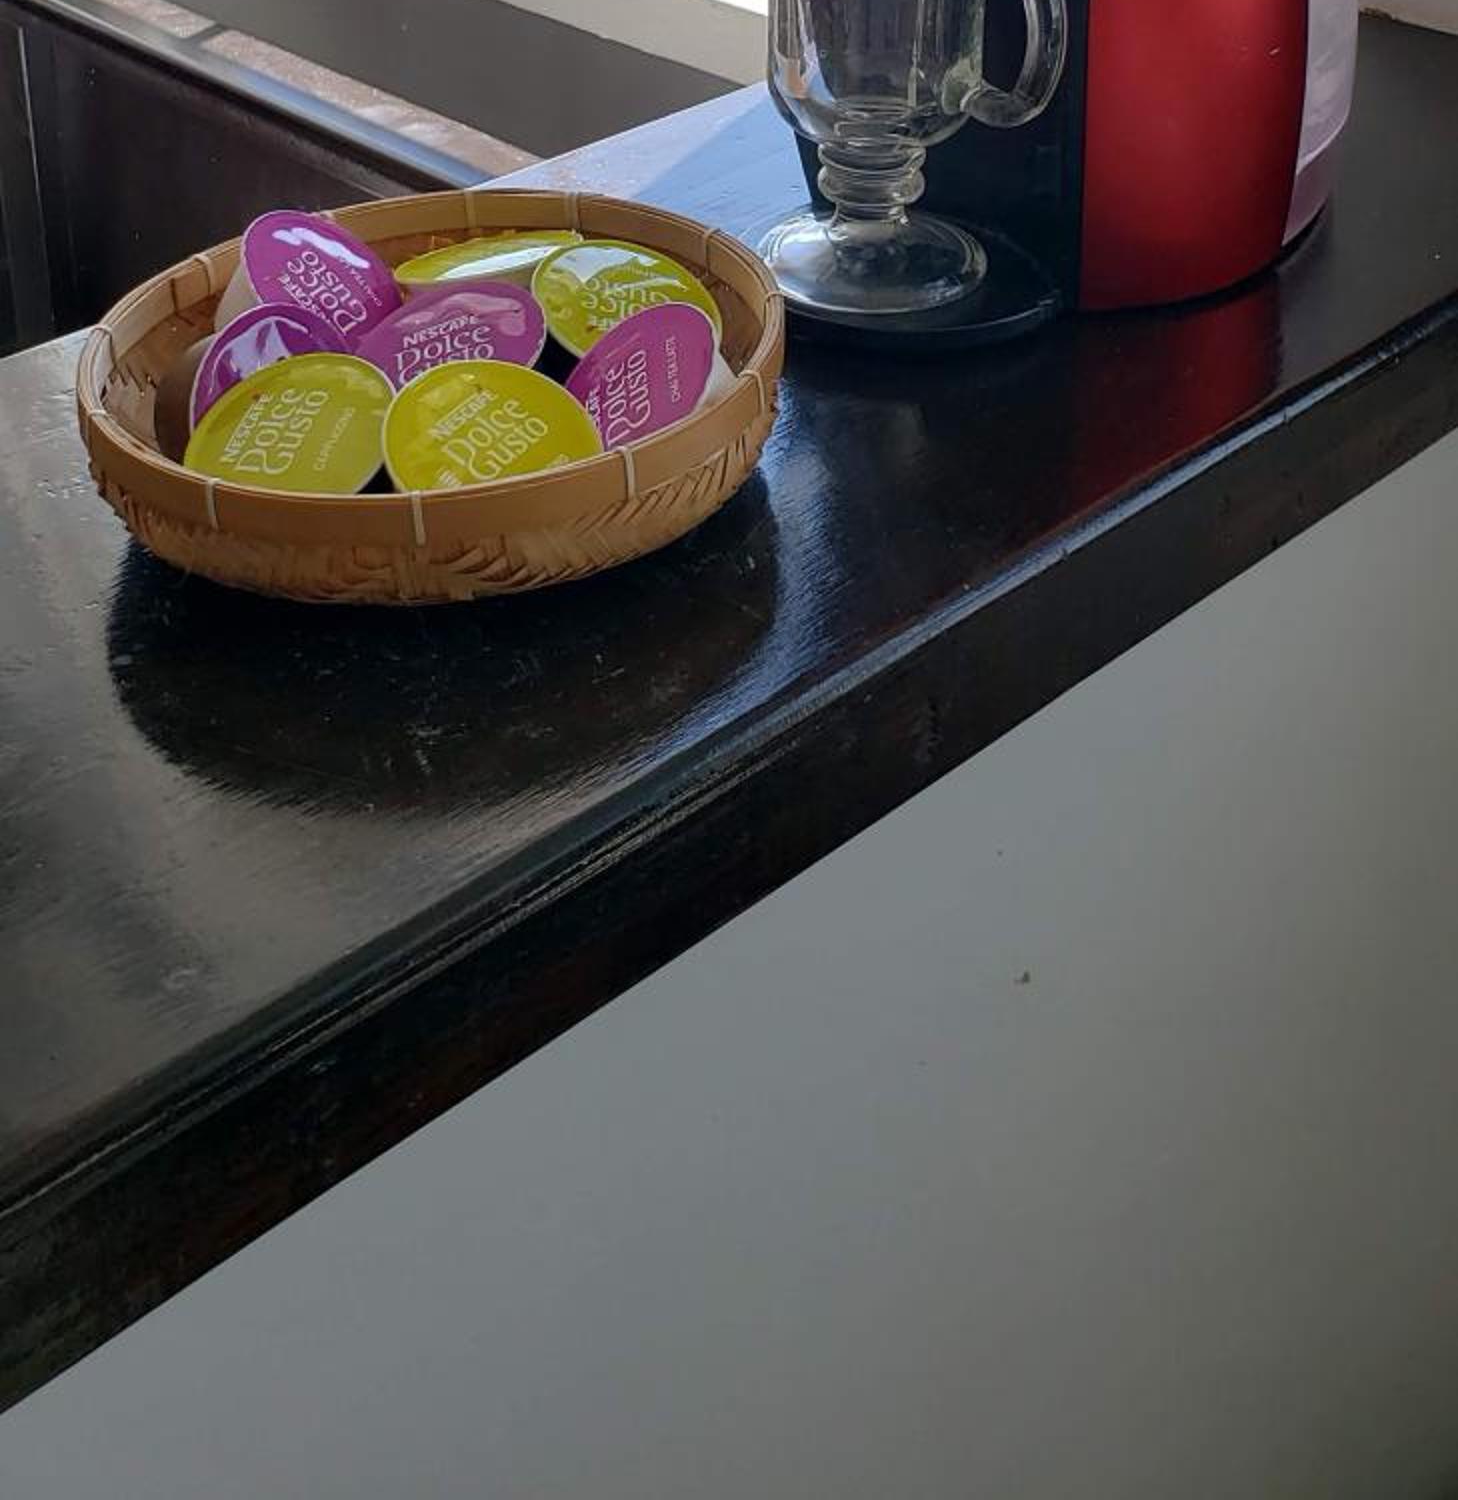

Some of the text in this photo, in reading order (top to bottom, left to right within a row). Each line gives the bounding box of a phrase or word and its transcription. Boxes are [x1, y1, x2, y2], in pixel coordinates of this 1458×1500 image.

[288, 257, 357, 336] Dolce
[301, 251, 367, 322] Gusto
[581, 291, 642, 318] olce
[395, 326, 490, 371] Dolce
[603, 362, 631, 444] Dolce
[627, 350, 650, 428] Gusto
[232, 389, 305, 471] Dolce
[261, 391, 328, 474] Gusto
[441, 399, 529, 466] Dolce
[468, 416, 548, 480] Gusto
